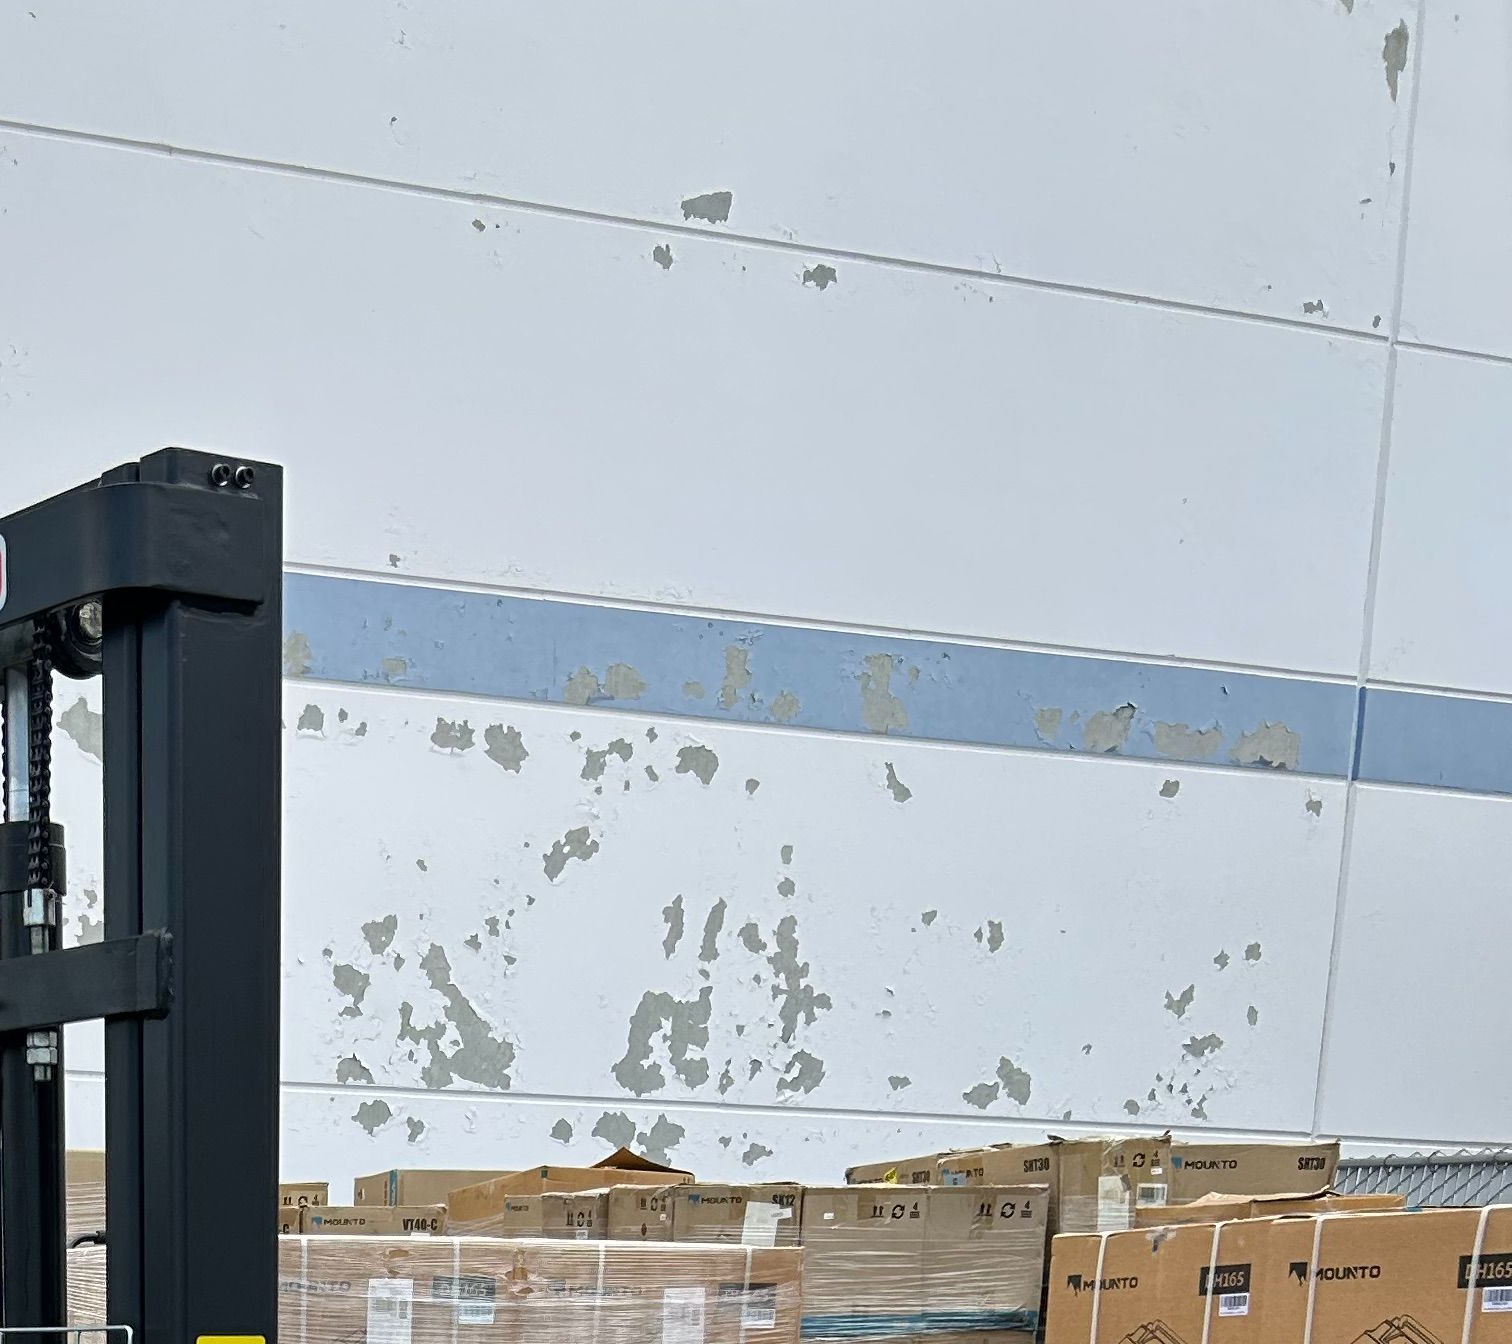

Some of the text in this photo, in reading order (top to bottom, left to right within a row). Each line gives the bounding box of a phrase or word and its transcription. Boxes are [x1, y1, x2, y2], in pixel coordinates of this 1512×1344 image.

[1184, 1159, 1237, 1170] MOUNTO
[402, 1218, 438, 1231] VT40-C
[1083, 1277, 1138, 1292] MUNTO
